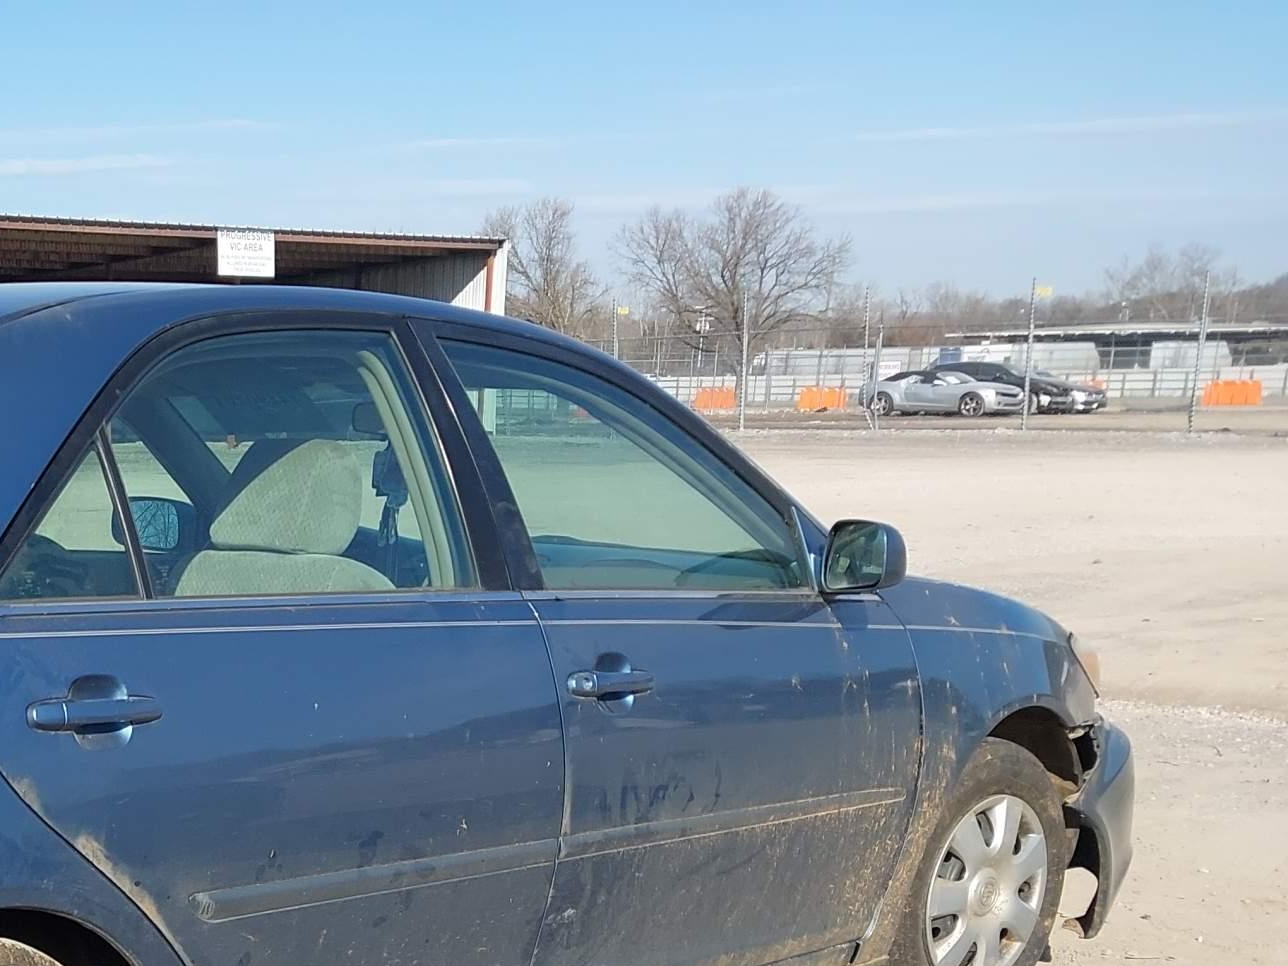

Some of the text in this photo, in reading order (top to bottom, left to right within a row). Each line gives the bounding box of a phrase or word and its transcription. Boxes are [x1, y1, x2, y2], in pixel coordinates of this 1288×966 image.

[220, 230, 273, 242] PROGRESSIVE
[230, 242, 263, 252] VIC AREA
